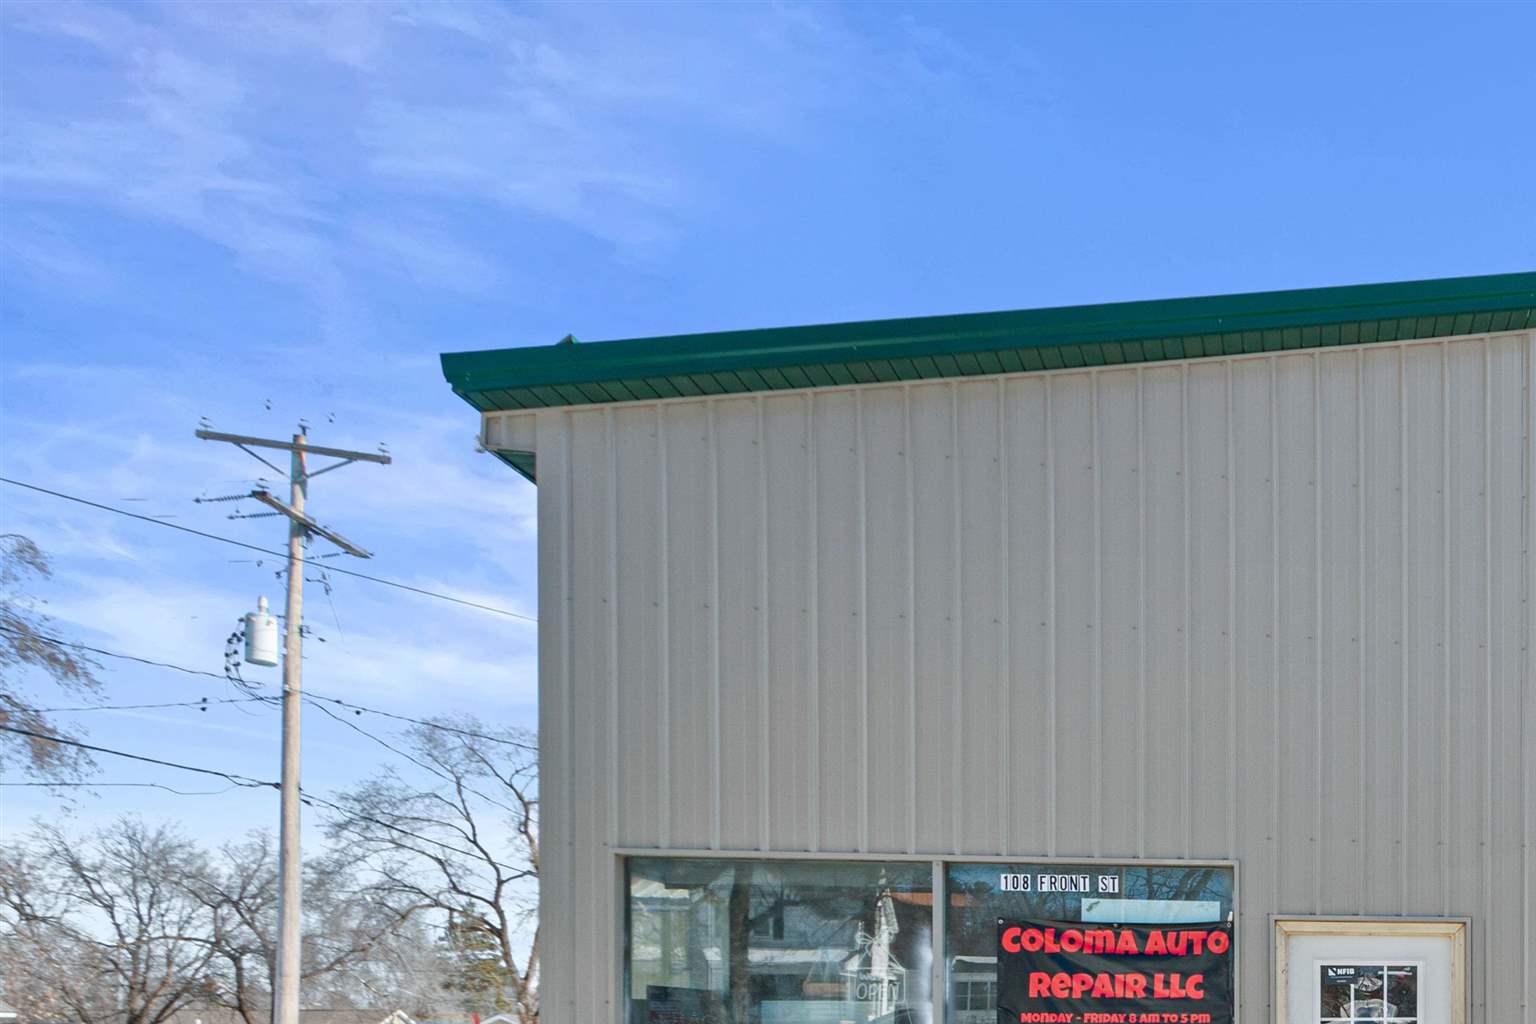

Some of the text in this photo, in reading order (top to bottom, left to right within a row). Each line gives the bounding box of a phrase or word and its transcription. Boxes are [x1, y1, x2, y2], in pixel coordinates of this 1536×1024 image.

[1003, 875, 1119, 893] 108 FRONT ST
[1144, 929, 1230, 956] AUTO
[1153, 973, 1205, 1000] LLC
[1083, 1012, 1127, 1024] FRIDAY
[1129, 1013, 1137, 1024] 8
[1162, 1013, 1178, 1024] TO
[1180, 1013, 1188, 1024] 5
